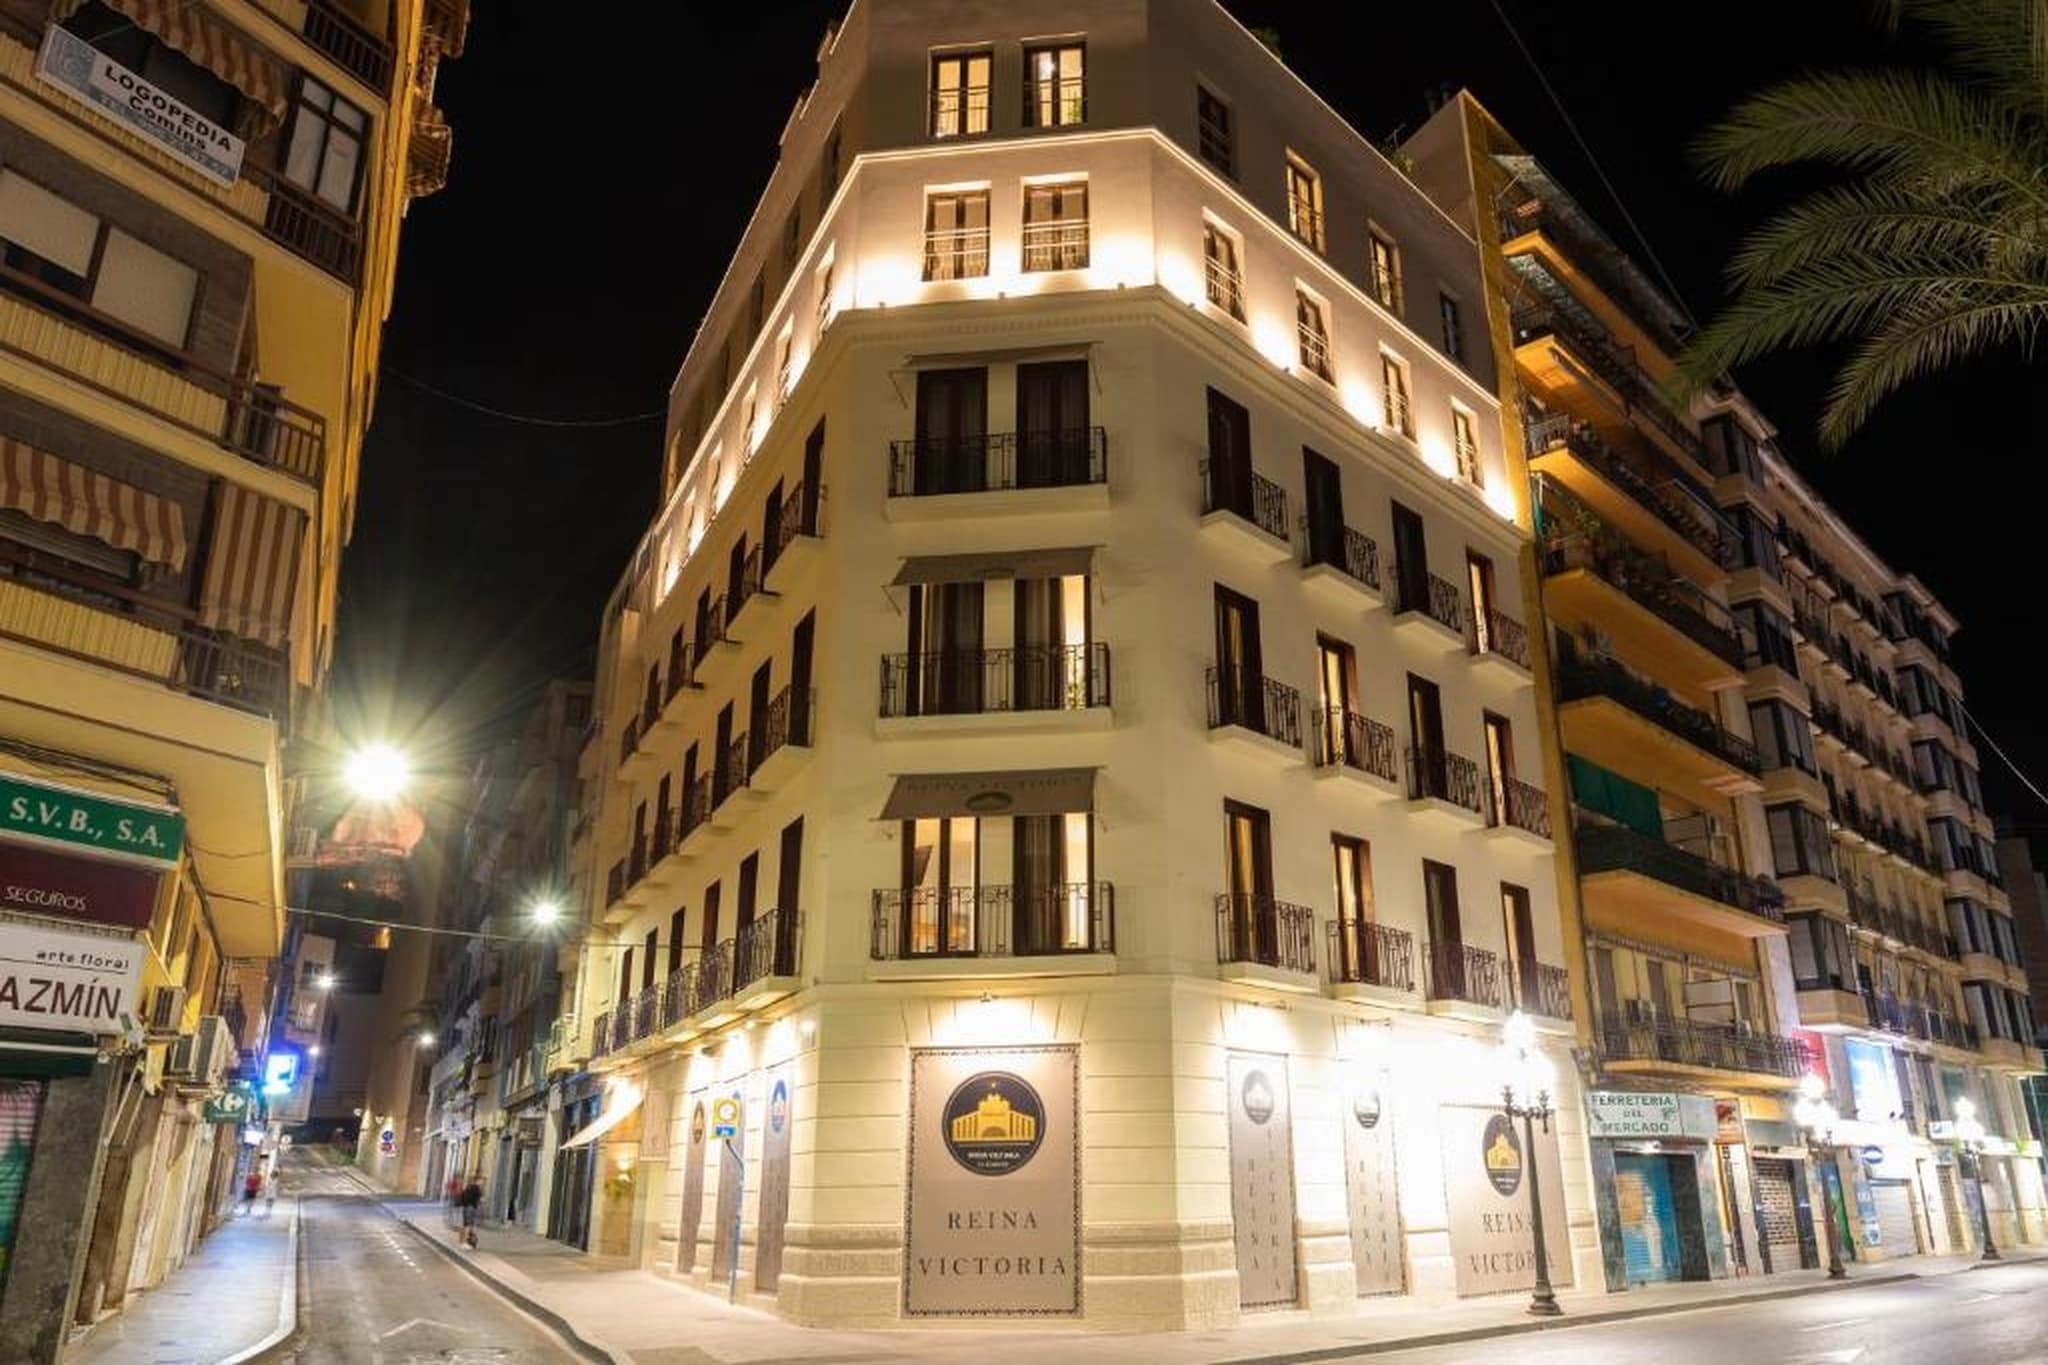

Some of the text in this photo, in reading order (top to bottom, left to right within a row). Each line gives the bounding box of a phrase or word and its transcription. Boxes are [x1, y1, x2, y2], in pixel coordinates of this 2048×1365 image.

[104, 64, 231, 151] LOGOPEDIA
[9, 796, 166, 849] S.V.B., S.A.
[5, 885, 87, 911] SEGUROS
[36, 950, 129, 969] arte floral
[1601, 1122, 1669, 1133] MERCADO
[948, 1212, 1038, 1230] REINA
[1482, 1212, 1535, 1233] REIN
[918, 1257, 1067, 1276] VICTORIA
[1469, 1251, 1555, 1274] VICTOR
